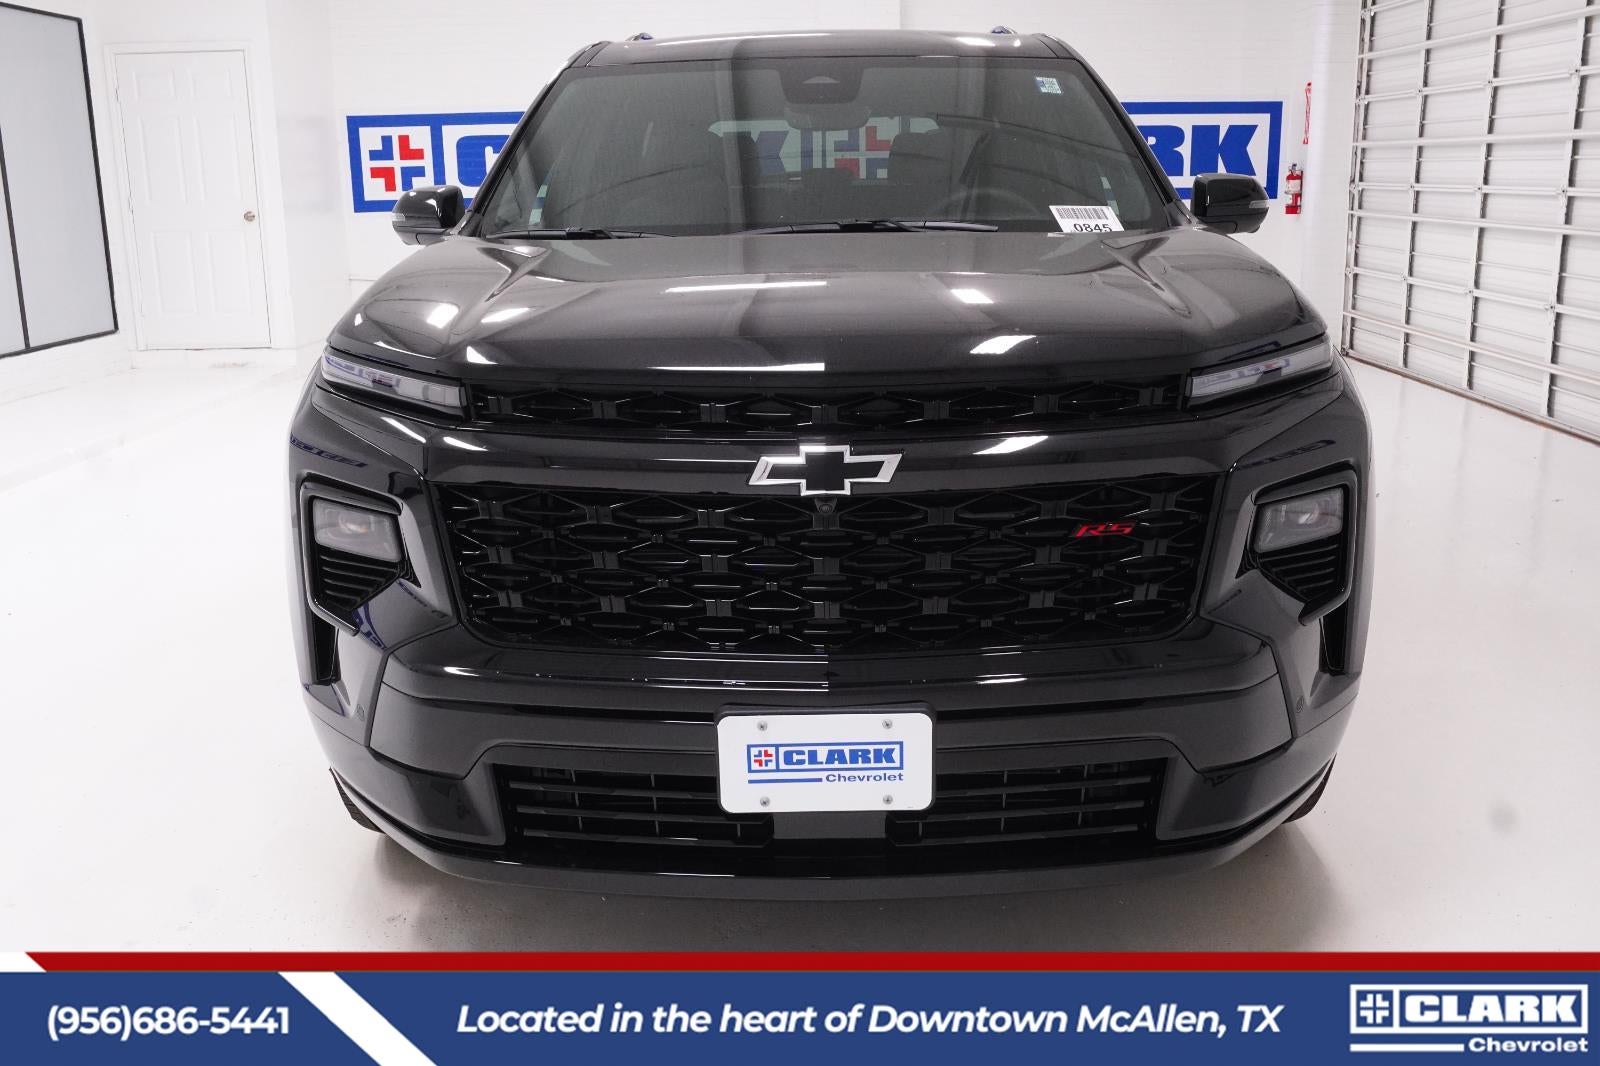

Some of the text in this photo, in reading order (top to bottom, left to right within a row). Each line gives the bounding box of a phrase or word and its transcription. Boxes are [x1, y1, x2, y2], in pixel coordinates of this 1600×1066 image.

[1074, 522, 1134, 539] RS
[783, 747, 896, 766] CLARK
[825, 773, 904, 783] Chevrolet
